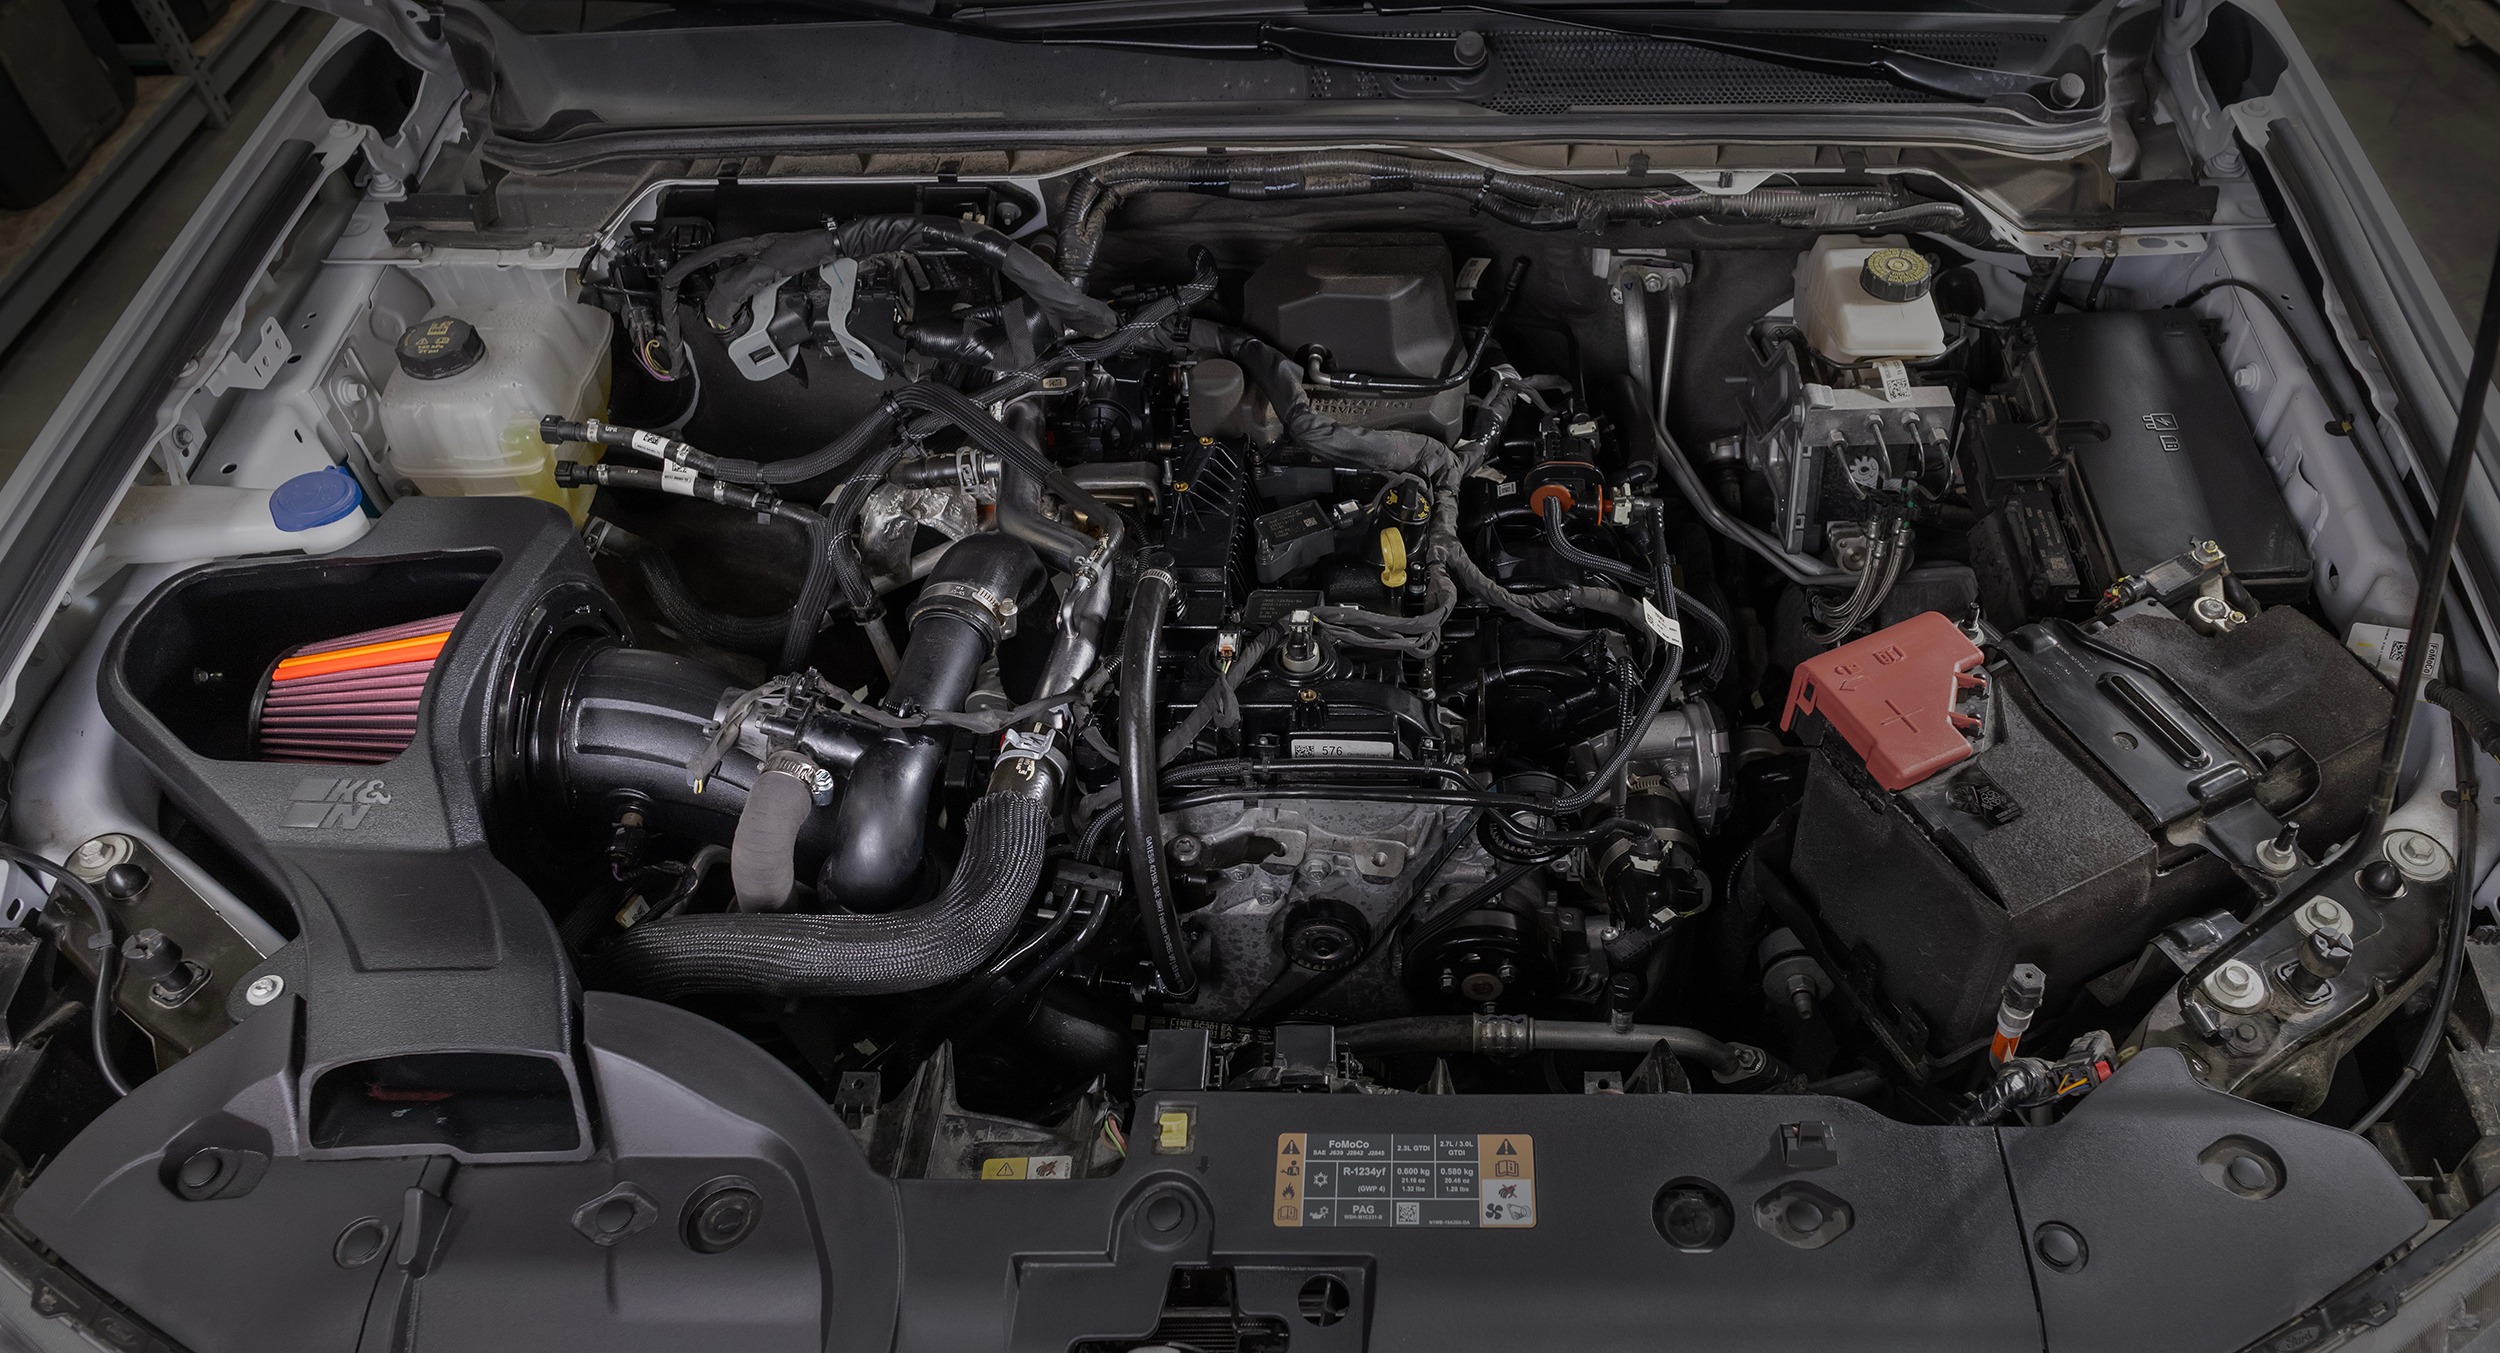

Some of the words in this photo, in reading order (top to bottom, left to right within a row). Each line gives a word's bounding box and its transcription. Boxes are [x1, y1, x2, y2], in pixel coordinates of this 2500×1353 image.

[2423, 644, 2438, 674] FoMoCo
[1322, 746, 1343, 756] 576
[1329, 1140, 1370, 1148] FoMoCo
[1343, 1167, 1386, 1177] R-1234yf
[1420, 1168, 1430, 1176] kg
[1464, 1168, 1474, 1176] kg
[1353, 1205, 1375, 1214] PAG
